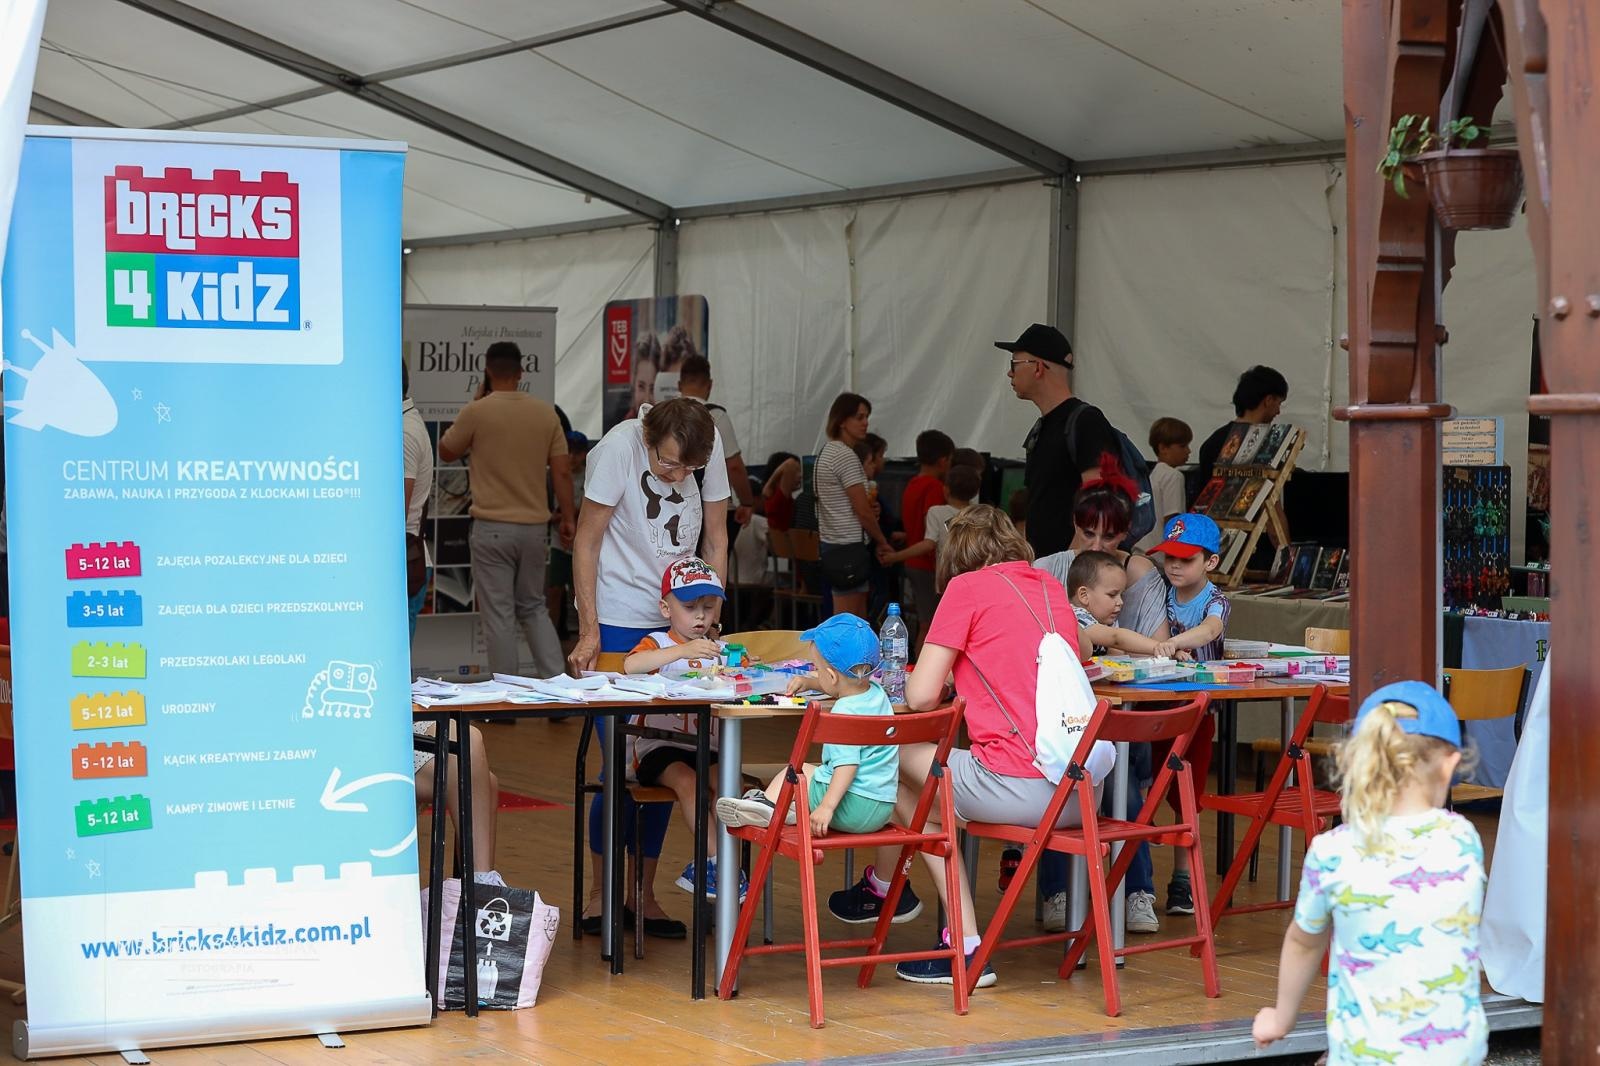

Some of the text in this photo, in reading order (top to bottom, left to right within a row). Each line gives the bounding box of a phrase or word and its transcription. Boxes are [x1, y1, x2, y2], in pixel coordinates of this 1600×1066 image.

[114, 269, 152, 320] 4
[460, 325, 493, 340] Miejska
[611, 320, 627, 333] TEB
[418, 341, 541, 373] Biblioa
[62, 455, 360, 481] CENTRUM KREATYWNOŚCI
[63, 488, 119, 500] ZABAWA,
[122, 488, 164, 499] NAUKA
[174, 488, 238, 499] PRZYGODA
[240, 488, 248, 499] Z
[250, 488, 310, 499] KLOCKAMI
[78, 557, 130, 571] 5-12 lat
[156, 554, 346, 569] ZAJĘCIA POZALEKCYJNE DLA DZIECI
[82, 605, 123, 618] 3-5 lat
[158, 602, 363, 617] ZAJĘCIA DLA DZIECI PRZEDSZKOLNYCH
[87, 656, 128, 669] 2-3 lat
[159, 654, 305, 668] PRZEDSZKOLAKI LEGOLAKI
[80, 706, 132, 721] 5-12 lat
[161, 703, 215, 714] URODZINY
[117, 756, 133, 768] lat
[163, 750, 316, 768] KĄCIK KREATYWNEJ ZABAWY
[166, 803, 204, 815] KAMPY
[207, 801, 249, 813] ZIMOWE
[258, 799, 295, 810] LETNIE
[87, 810, 139, 827] 5-12 lat
[81, 916, 371, 959] www.bricks4kidz.com.pl
